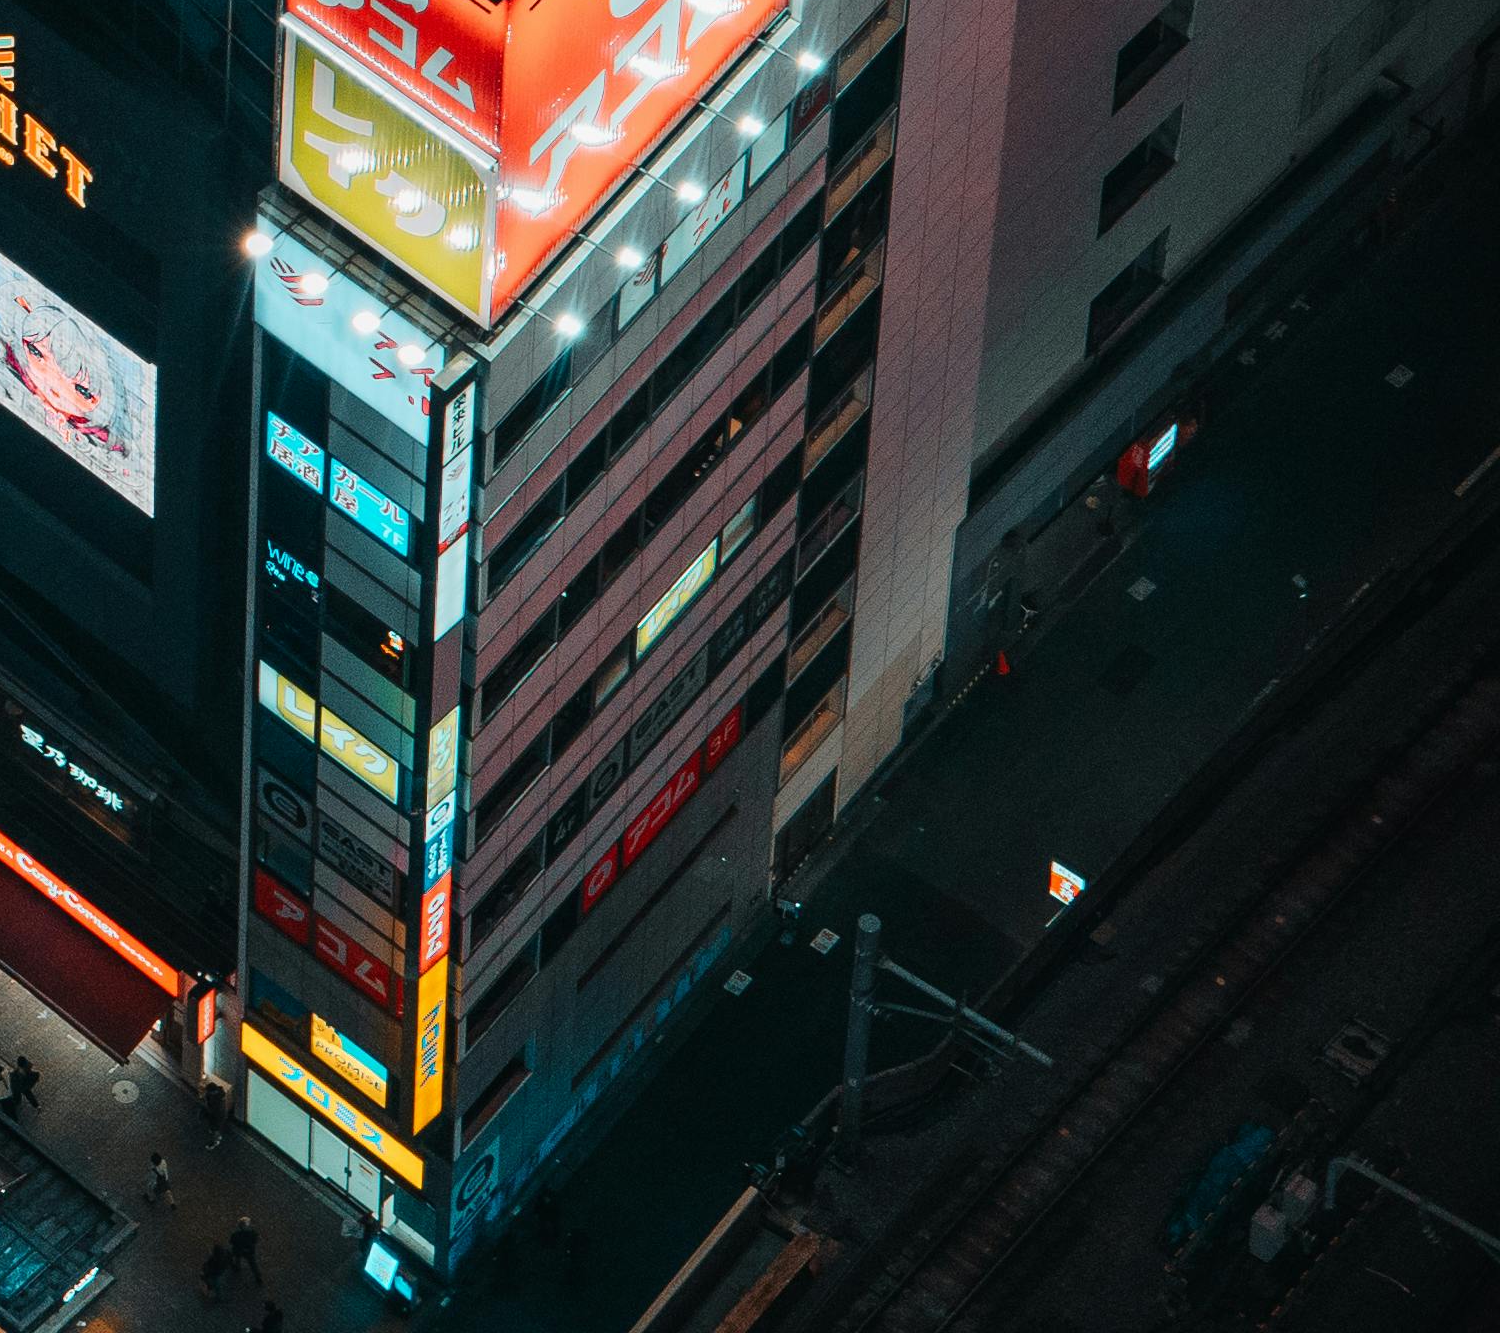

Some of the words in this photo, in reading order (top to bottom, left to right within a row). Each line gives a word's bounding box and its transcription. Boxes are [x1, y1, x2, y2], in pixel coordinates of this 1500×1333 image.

[268, 435, 361, 519] 居酒屋
[380, 520, 407, 548] 7F
[641, 553, 715, 651] レイク
[629, 769, 698, 856] アコム
[267, 882, 392, 1001] アコム
[276, 1051, 390, 1156] プロミス
